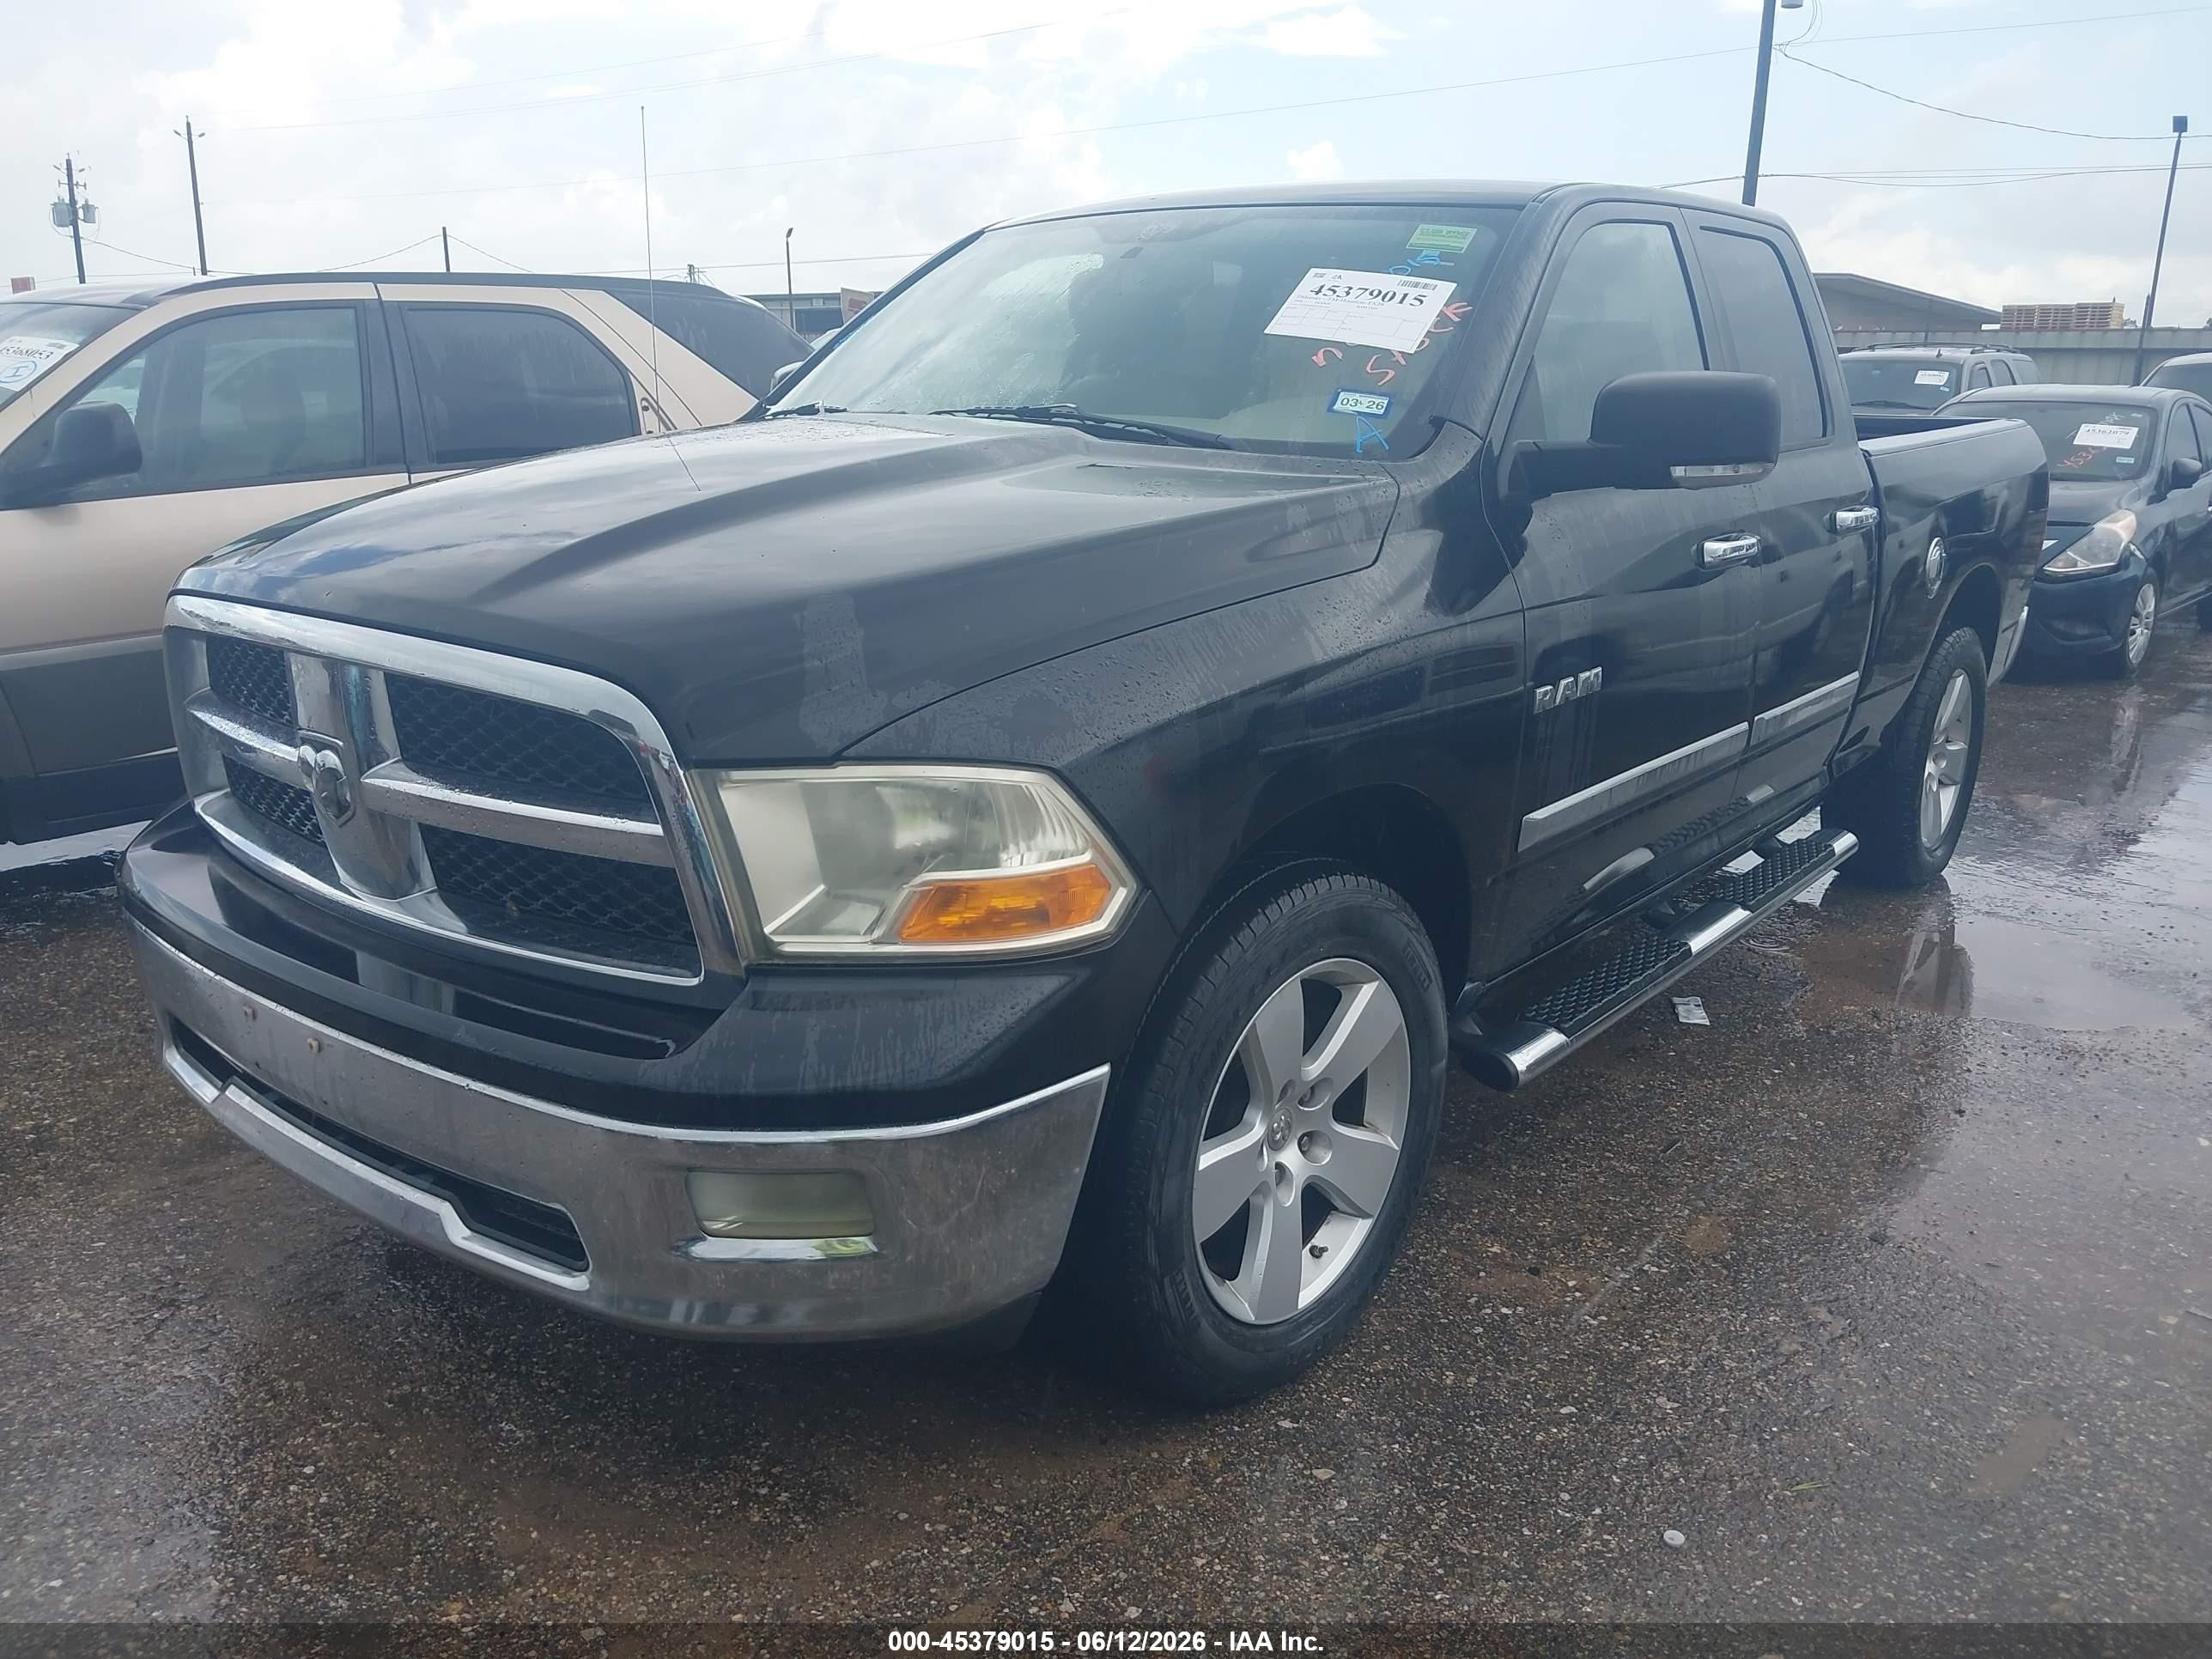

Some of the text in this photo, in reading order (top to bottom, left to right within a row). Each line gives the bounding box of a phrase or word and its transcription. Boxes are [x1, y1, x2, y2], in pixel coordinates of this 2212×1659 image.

[1310, 283, 1430, 307] 45379015
[1340, 397, 1386, 410] 03 26
[1533, 665, 1602, 714] RAM
